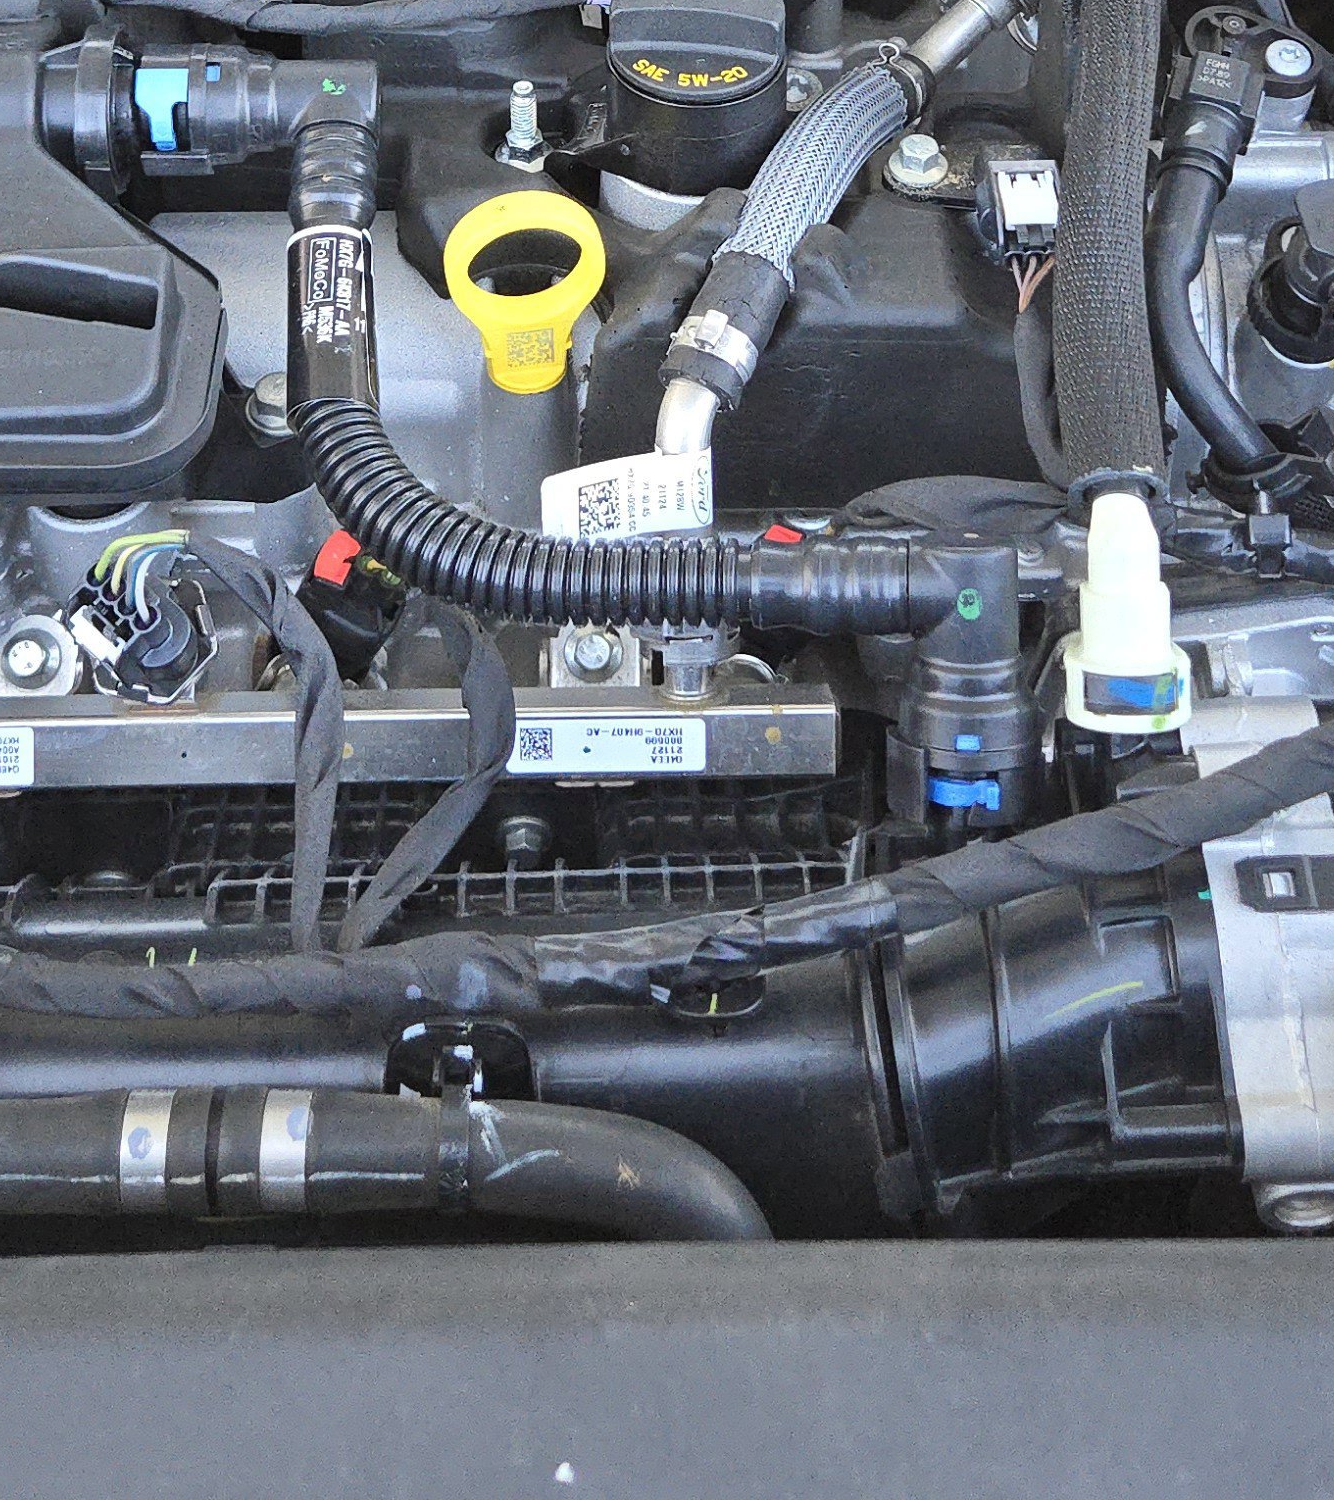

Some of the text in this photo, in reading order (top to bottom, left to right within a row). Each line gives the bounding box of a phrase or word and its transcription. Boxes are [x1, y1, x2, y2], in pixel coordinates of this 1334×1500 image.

[632, 57, 748, 88] SAE 5W-20
[313, 239, 329, 299] FoMoCo
[652, 746, 682, 754] 21127
